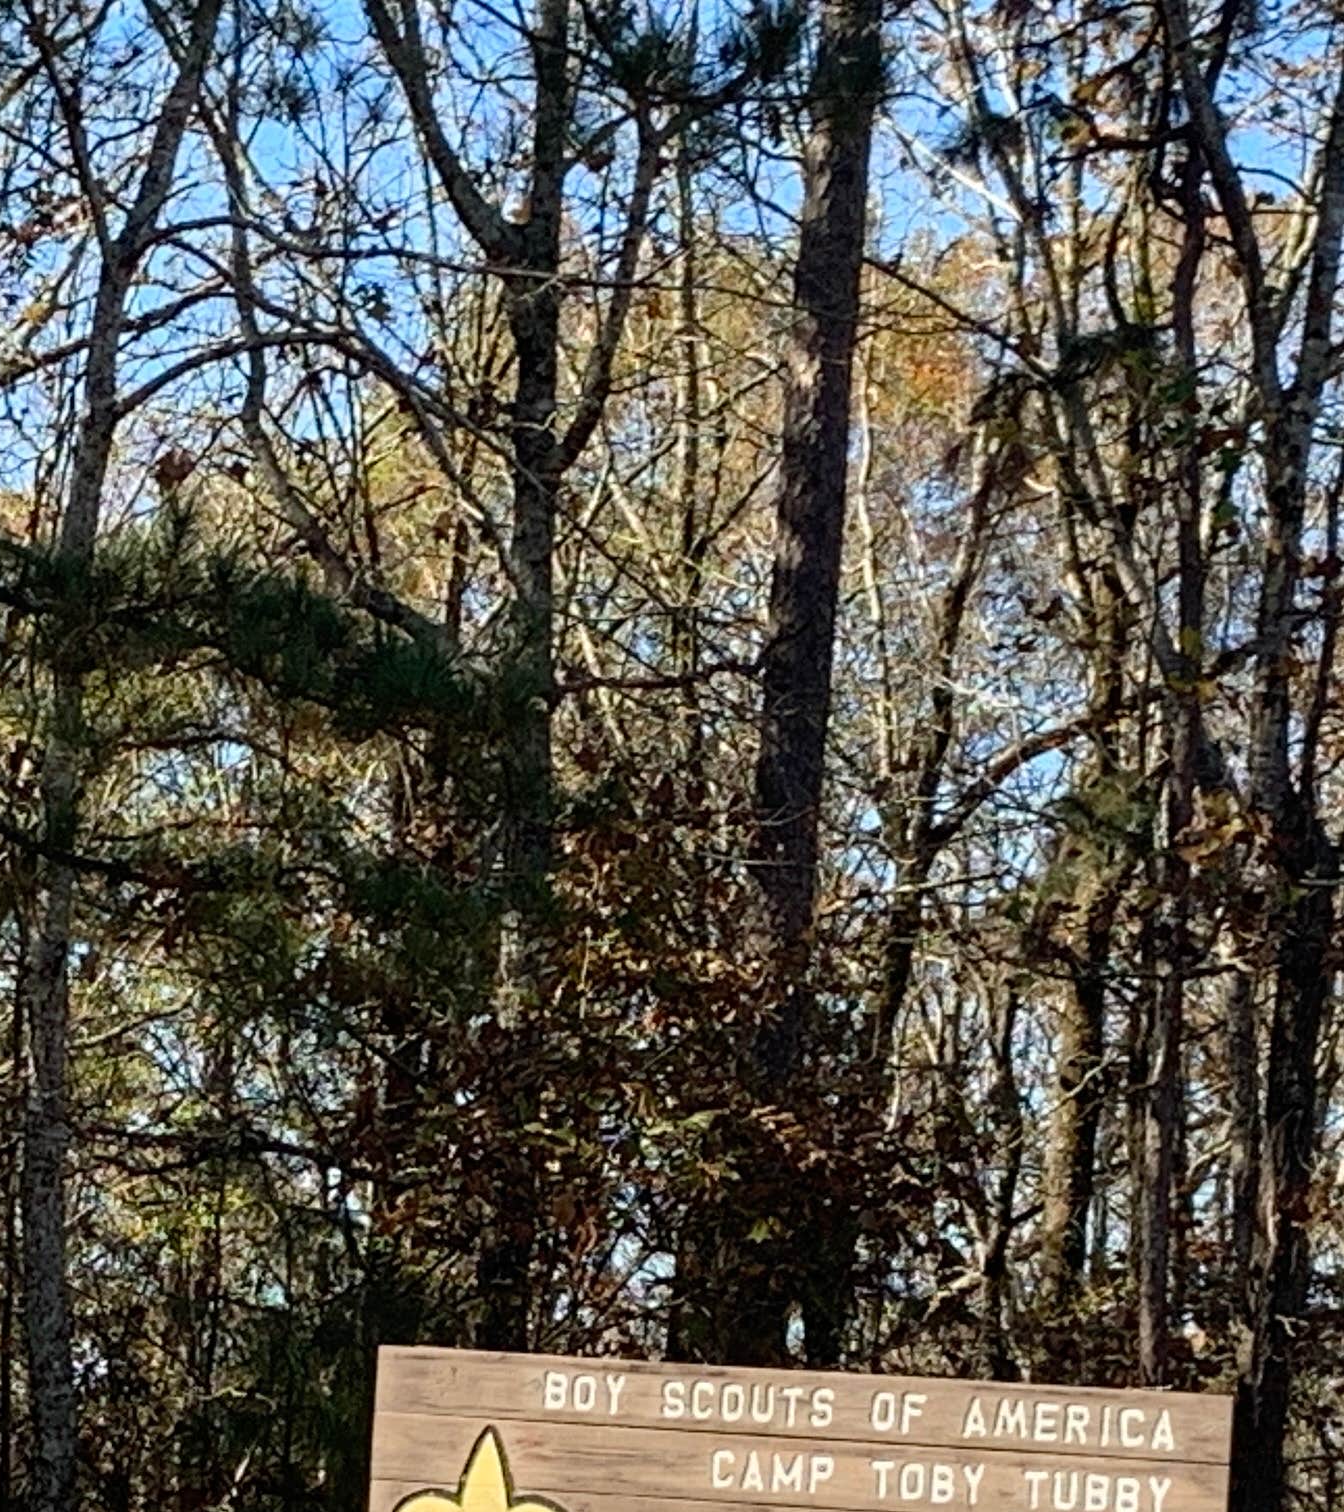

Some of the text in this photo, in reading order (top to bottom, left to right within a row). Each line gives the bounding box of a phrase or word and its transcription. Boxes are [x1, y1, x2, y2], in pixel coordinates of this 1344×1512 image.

[543, 1370, 1176, 1452] BOY SCOUTS OF AMERICA
[710, 1449, 835, 1493] CAMP
[870, 1460, 985, 1504] TOBY
